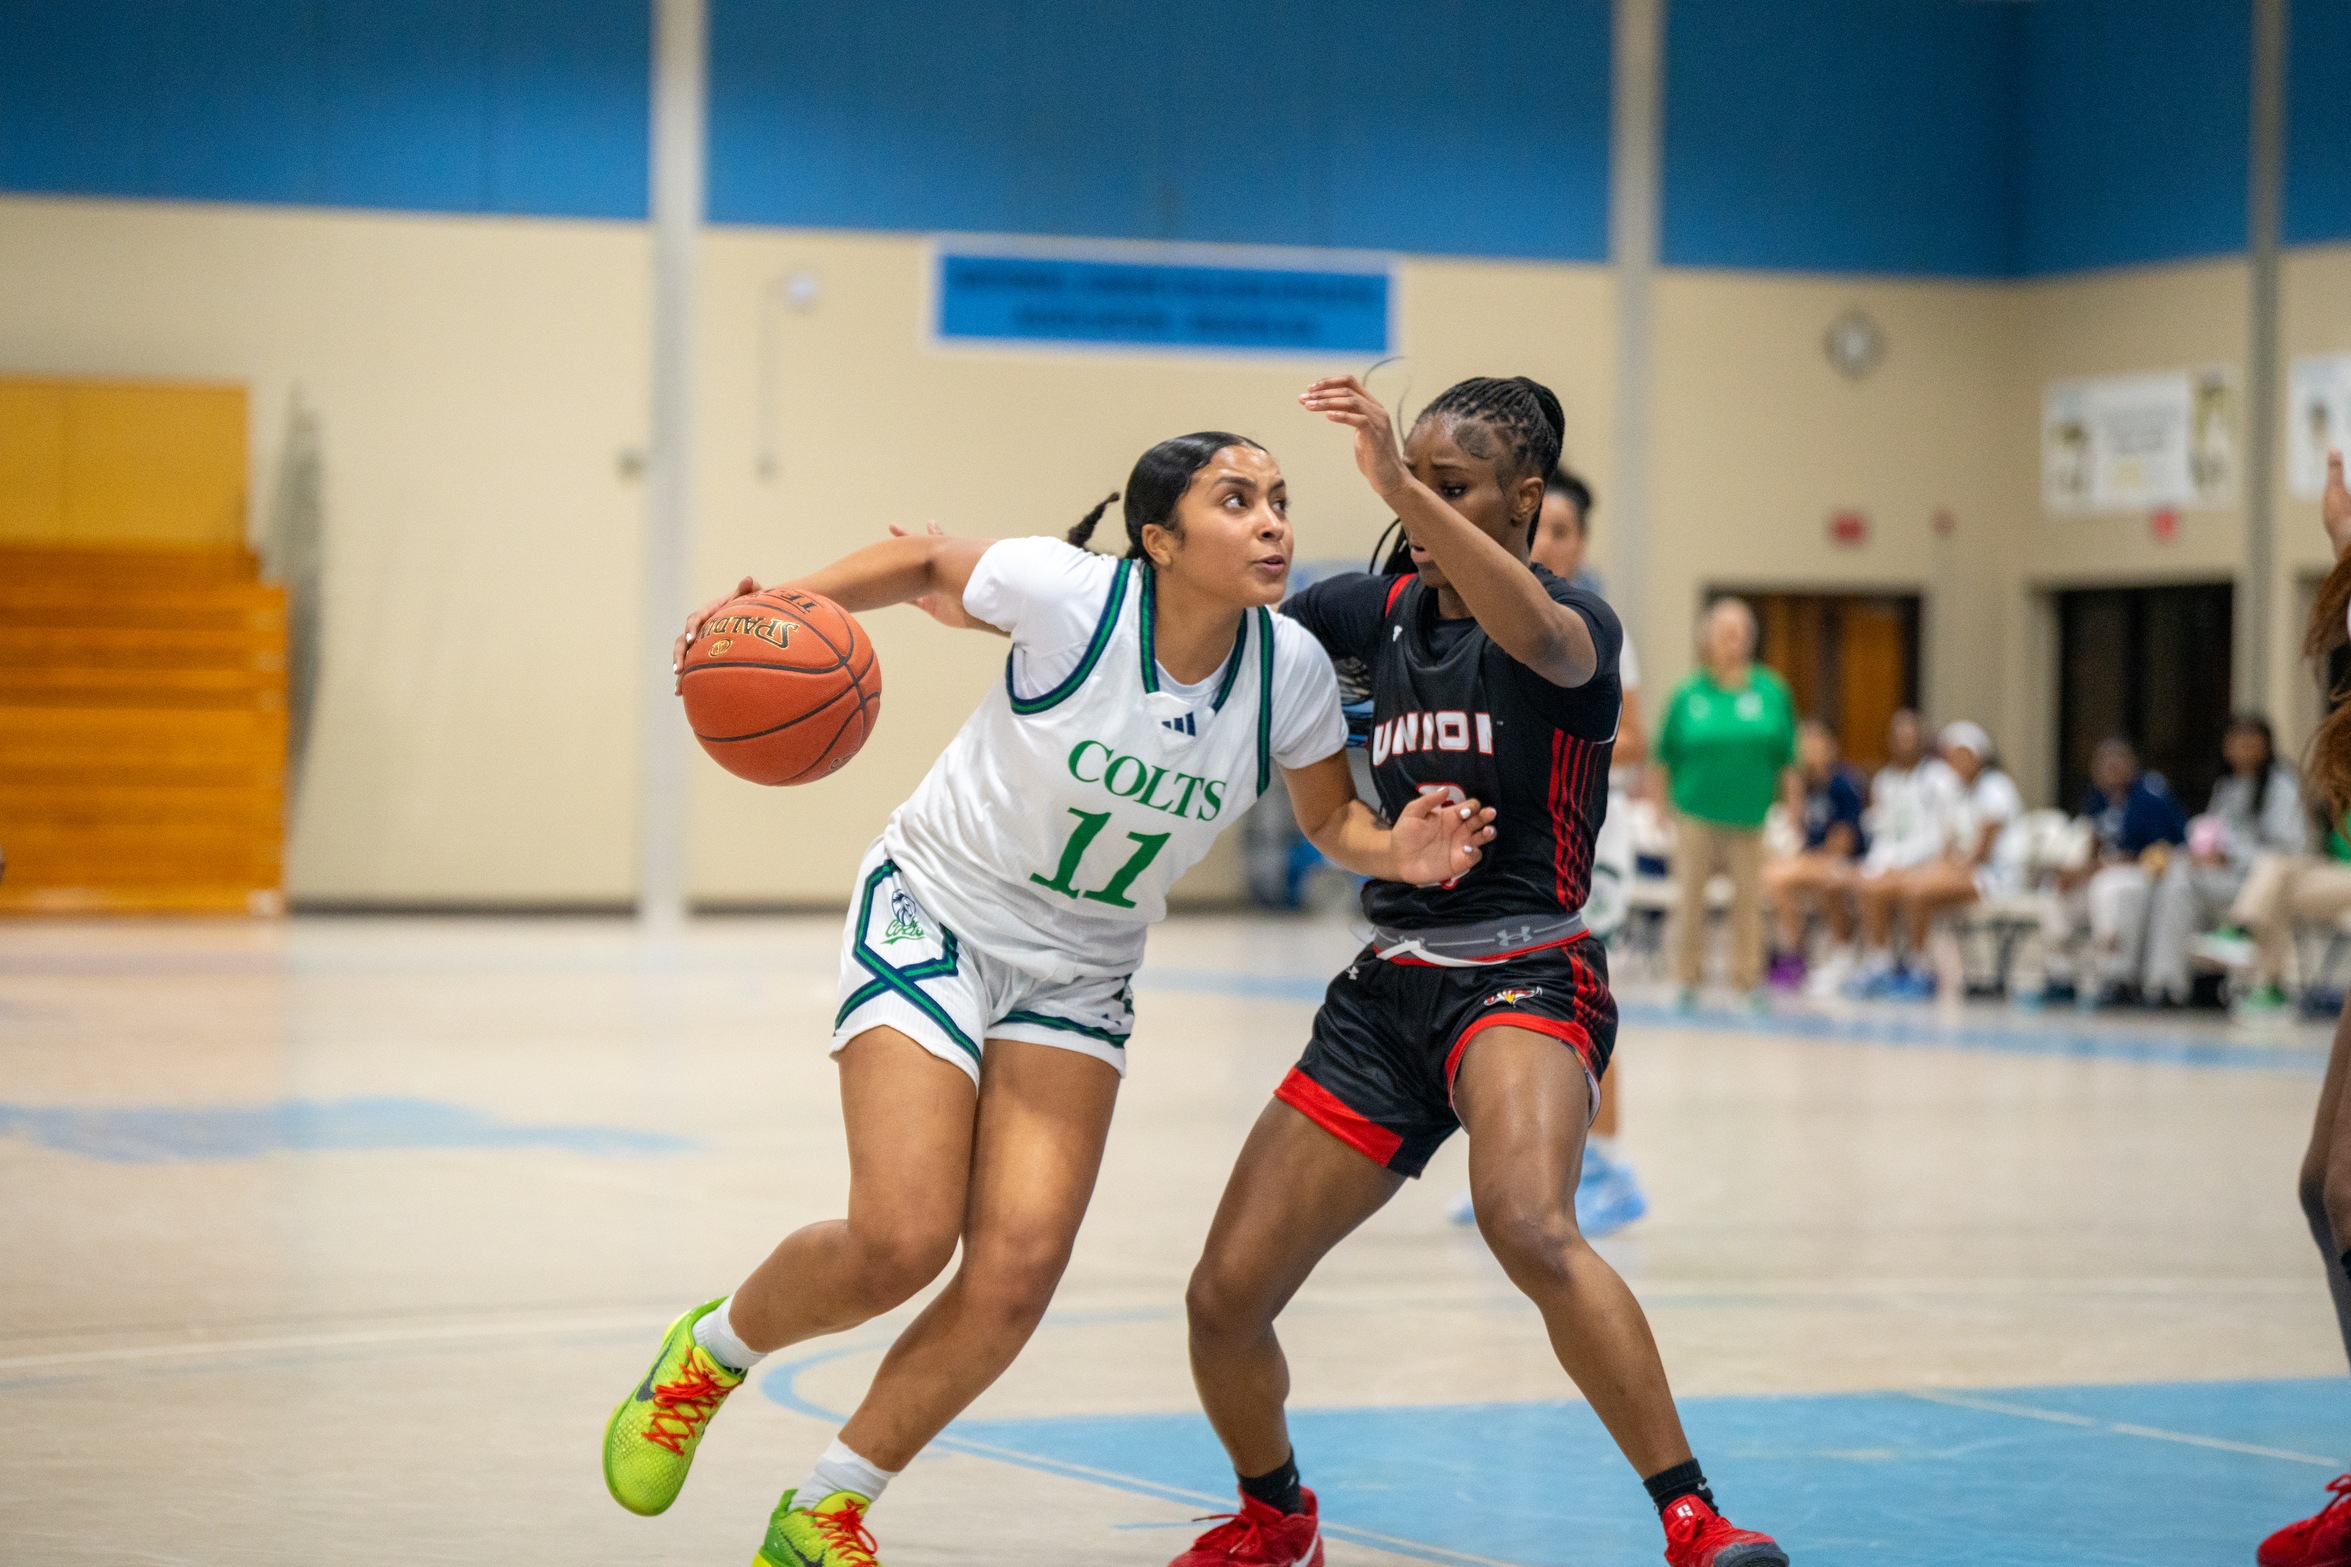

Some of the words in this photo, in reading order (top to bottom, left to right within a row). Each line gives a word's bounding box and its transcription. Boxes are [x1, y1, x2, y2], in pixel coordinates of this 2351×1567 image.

[697, 615, 800, 649] SPALDIN
[1068, 739, 1228, 821] COLTS
[1029, 807, 1172, 909] 11
